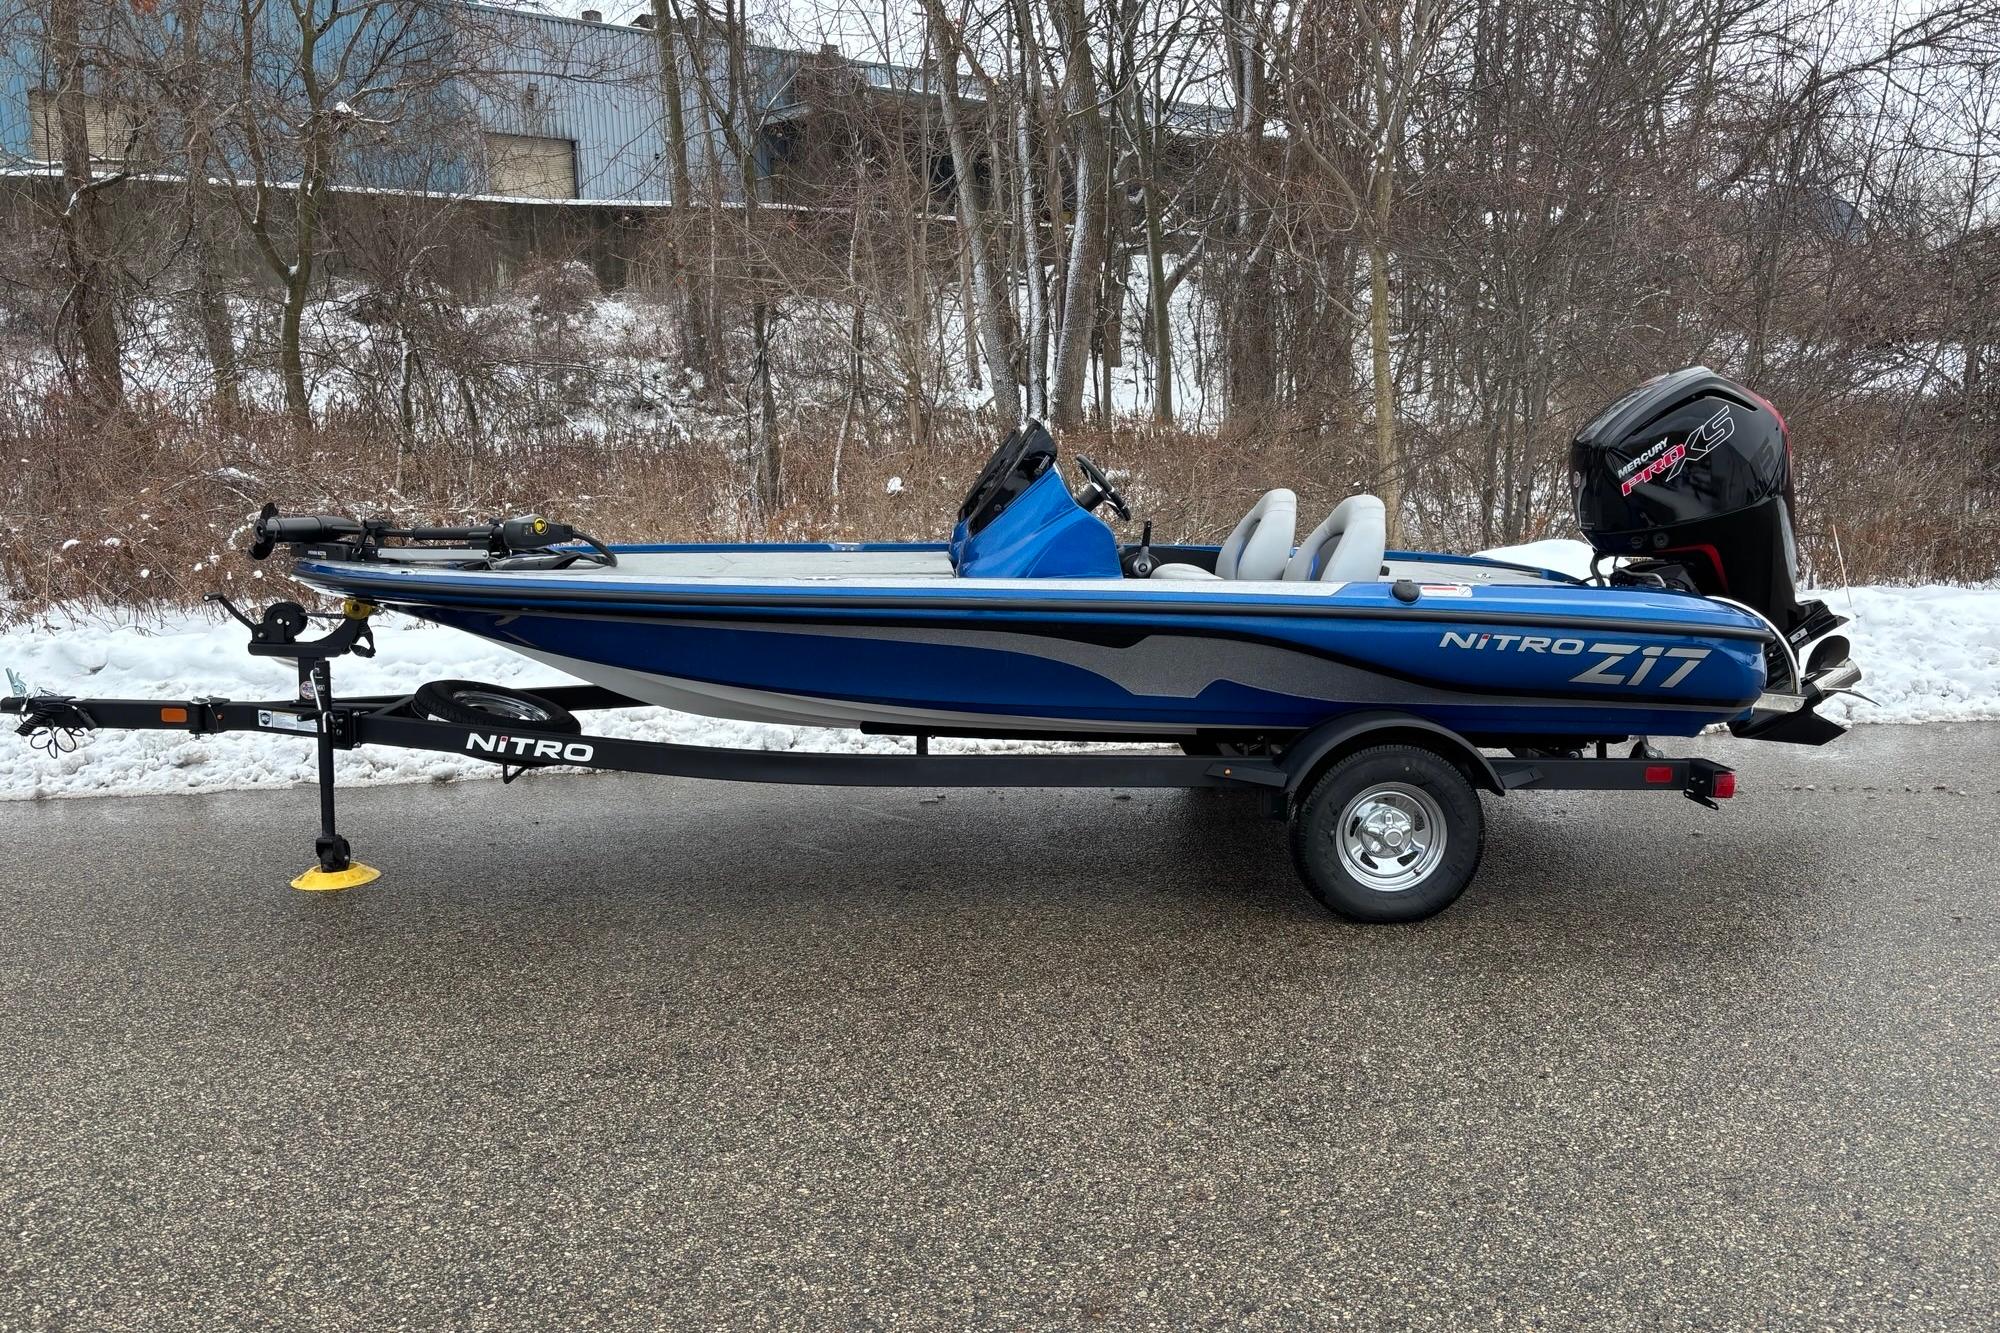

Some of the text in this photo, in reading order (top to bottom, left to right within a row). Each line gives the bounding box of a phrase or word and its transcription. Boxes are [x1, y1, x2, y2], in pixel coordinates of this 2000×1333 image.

[1617, 437, 1669, 478] MERCURY
[1621, 443, 1686, 496] PRO
[1568, 643, 1713, 688] Z17
